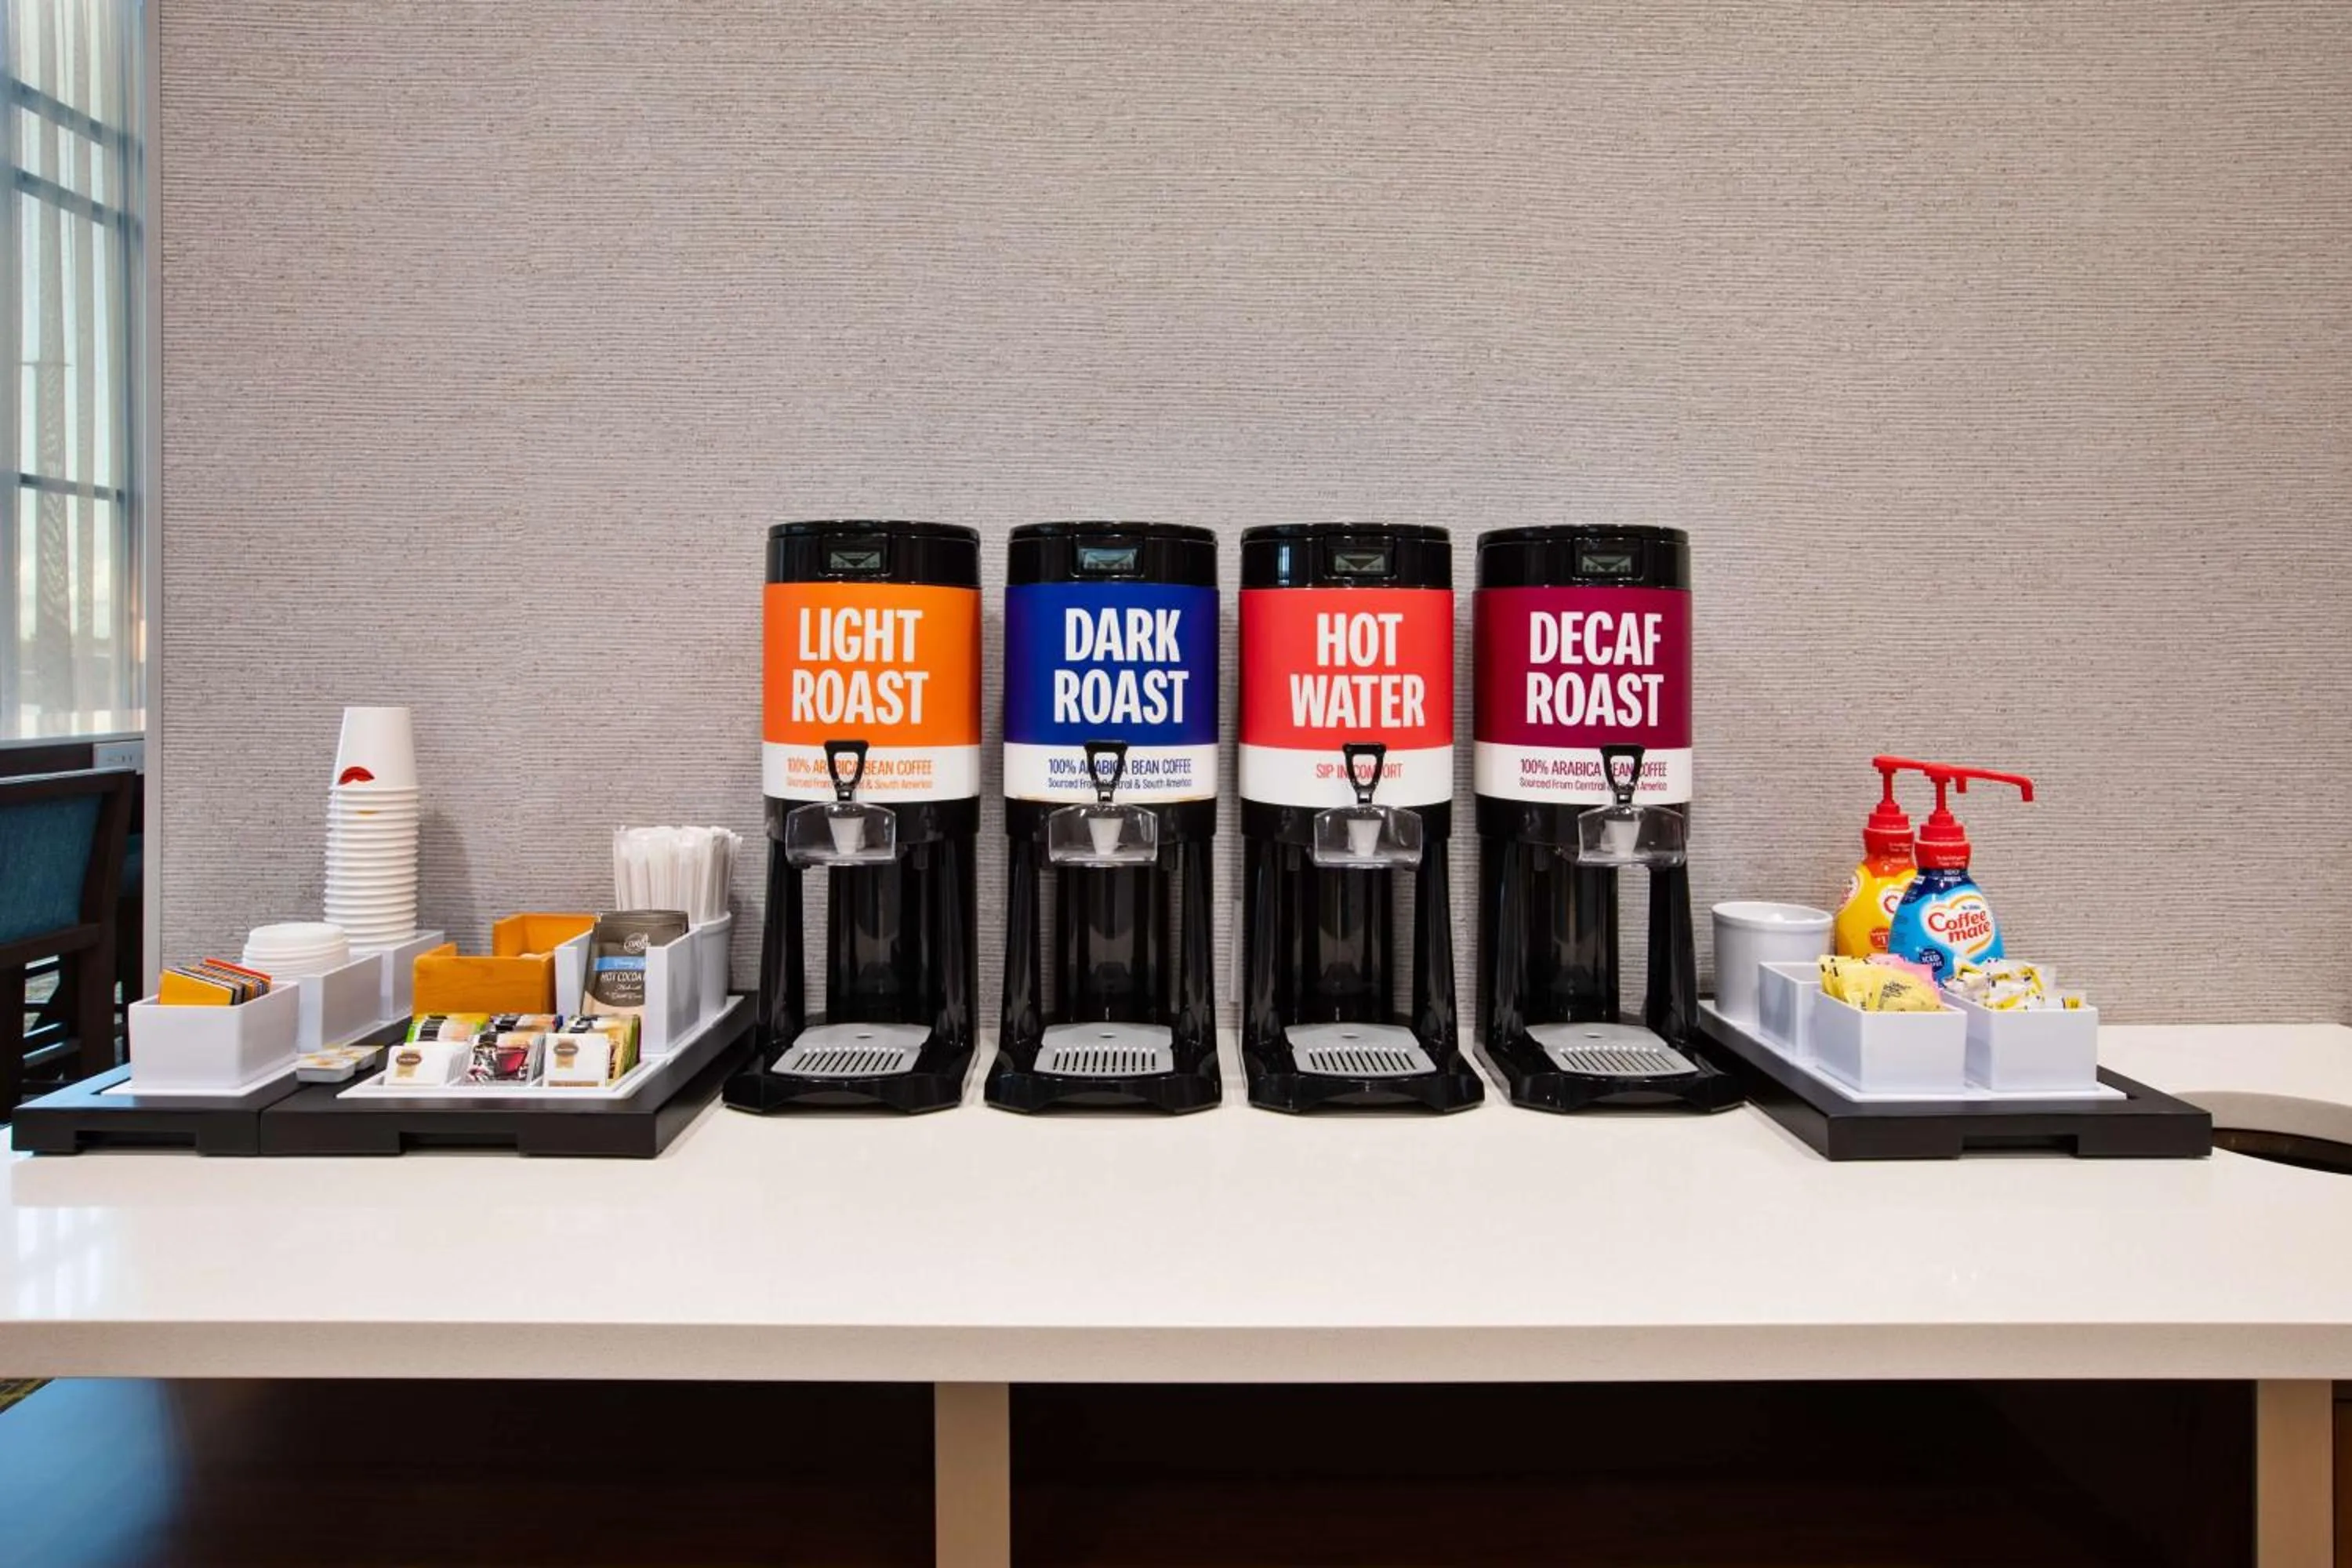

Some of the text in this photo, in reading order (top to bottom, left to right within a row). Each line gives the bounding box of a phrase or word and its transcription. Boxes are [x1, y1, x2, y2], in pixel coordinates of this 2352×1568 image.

[799, 607, 924, 662] LIGHT
[1065, 608, 1181, 662] DARK
[1316, 612, 1404, 667] HOT
[1530, 611, 1663, 666] DECAF
[792, 669, 929, 725] ROAST
[1054, 669, 1189, 724] ROAST
[1290, 673, 1425, 728] WATER
[1526, 672, 1664, 727] ROAST
[787, 757, 810, 774] 100%
[896, 760, 932, 775] COFFEE
[1048, 758, 1076, 775] 100%
[1131, 760, 1160, 775] BEAN
[1162, 758, 1192, 775] COFFEE
[1316, 763, 1403, 779] SIP IN COMORT
[1521, 758, 1548, 775] 100%
[1552, 760, 1602, 777] ARABICA
[1928, 910, 1991, 943] Coffee mate
